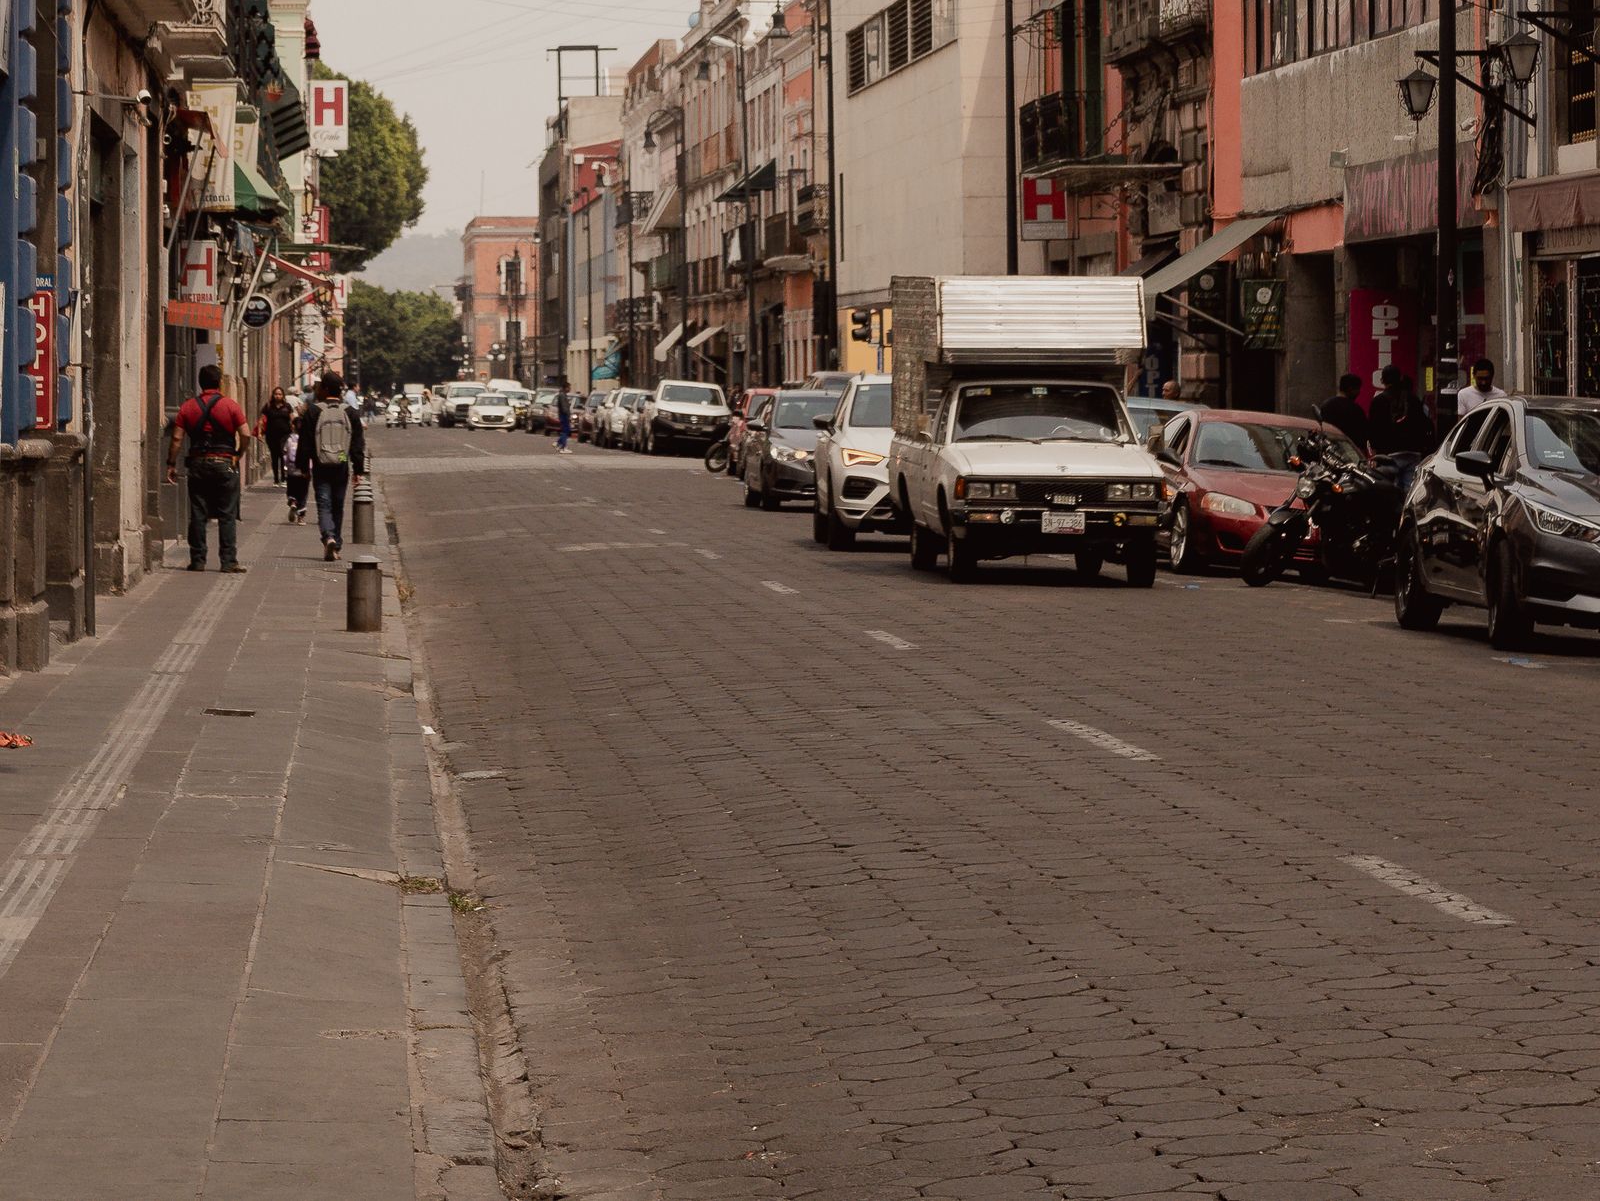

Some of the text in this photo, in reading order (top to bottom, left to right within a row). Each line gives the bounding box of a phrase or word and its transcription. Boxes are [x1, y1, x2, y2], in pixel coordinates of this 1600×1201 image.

[314, 87, 344, 126] H
[1023, 176, 1066, 220] H
[35, 277, 53, 288] DRAL
[181, 247, 213, 287] H
